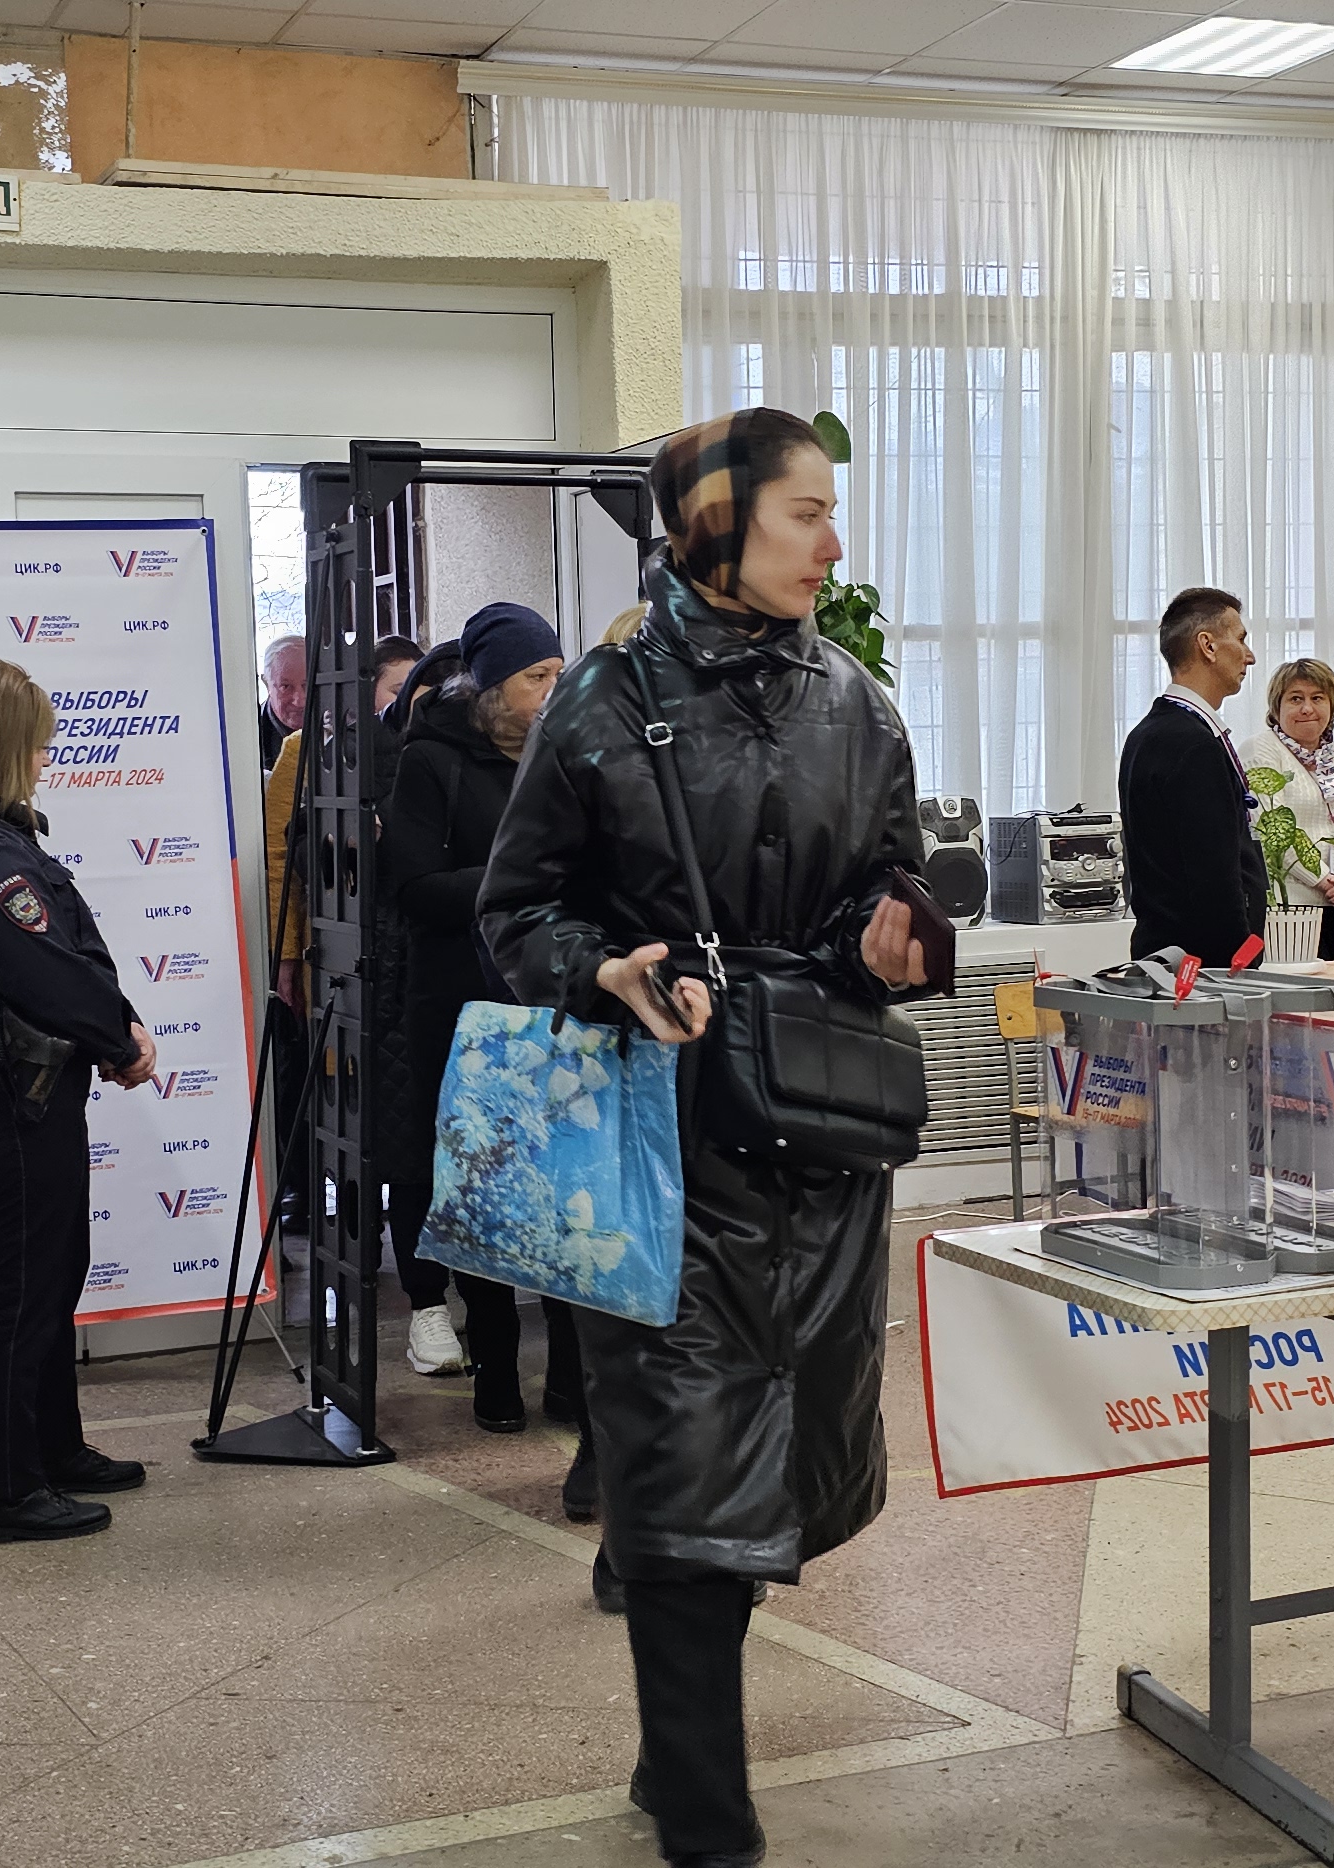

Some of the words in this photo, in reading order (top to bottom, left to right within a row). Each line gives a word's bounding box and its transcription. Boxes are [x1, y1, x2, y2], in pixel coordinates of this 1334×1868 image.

[15, 562, 61, 576] ЦИК.РФ
[124, 620, 169, 633] ЦИК.РФ
[50, 690, 149, 710] ВЫБОРЫ
[52, 715, 180, 739] РЕЗИДЕНТА
[47, 744, 120, 765] ОССИИ
[67, 770, 122, 788] МАРТА
[125, 768, 165, 787] 2024
[145, 905, 192, 919] ЦИК.РФ
[154, 1022, 201, 1036] ЦИК.РФ
[1092, 1054, 1134, 1074] ВЫБОРЫ
[1088, 1073, 1147, 1096] ПРЕЗИДЕНТА
[1084, 1091, 1123, 1110] РОССИИ
[163, 1139, 210, 1154] ЦИК.РФ
[173, 1258, 220, 1274] ЦИК.РФ
